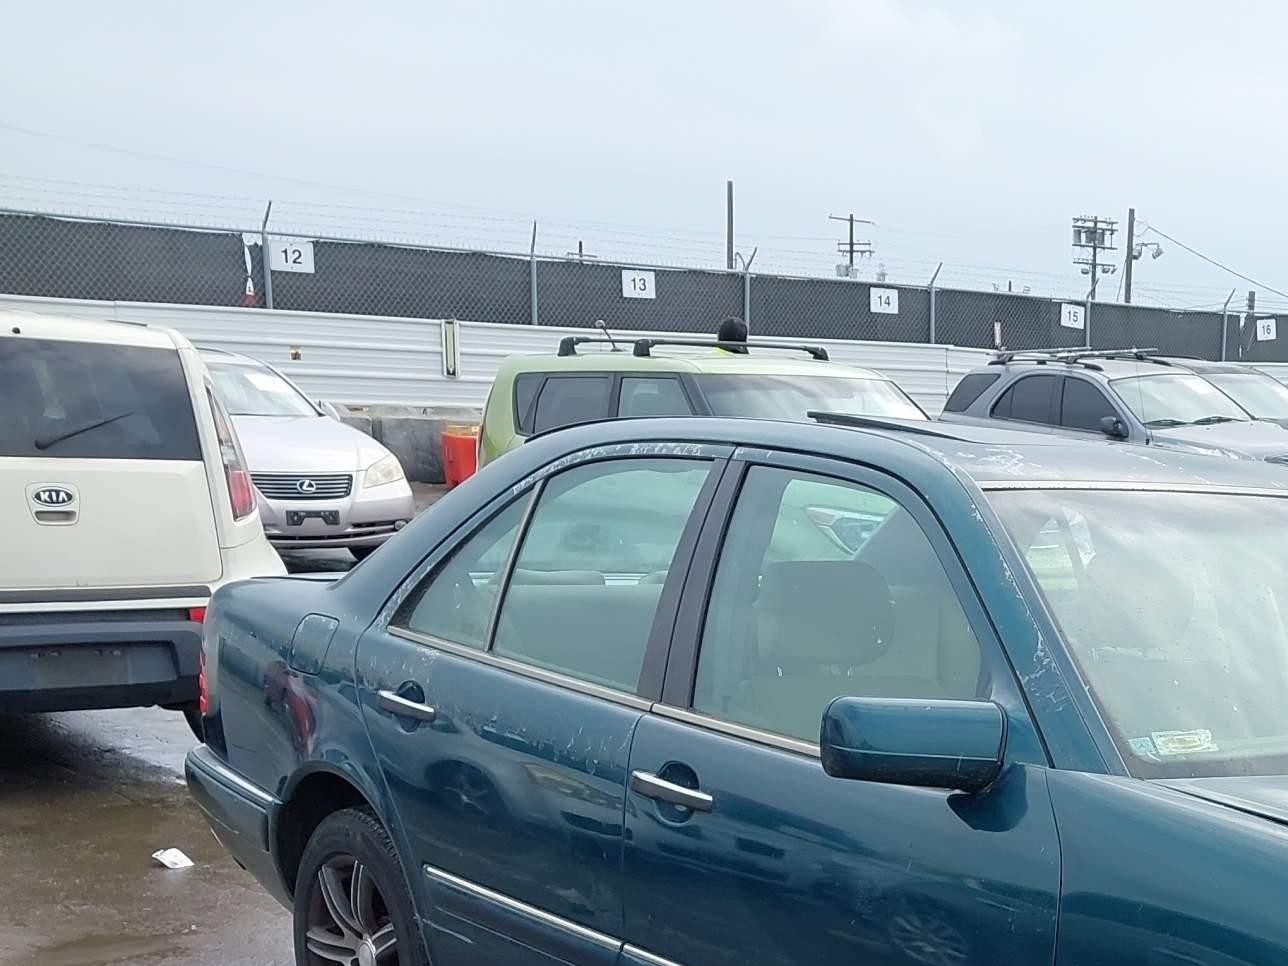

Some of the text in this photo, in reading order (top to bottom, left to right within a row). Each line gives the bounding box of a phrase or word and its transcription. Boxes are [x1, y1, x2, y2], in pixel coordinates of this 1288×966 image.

[281, 247, 303, 265] 12
[630, 277, 647, 292] 13
[877, 295, 891, 307] 14
[1066, 309, 1079, 323] 15
[1261, 324, 1272, 336] 16
[39, 491, 69, 503] KIA
